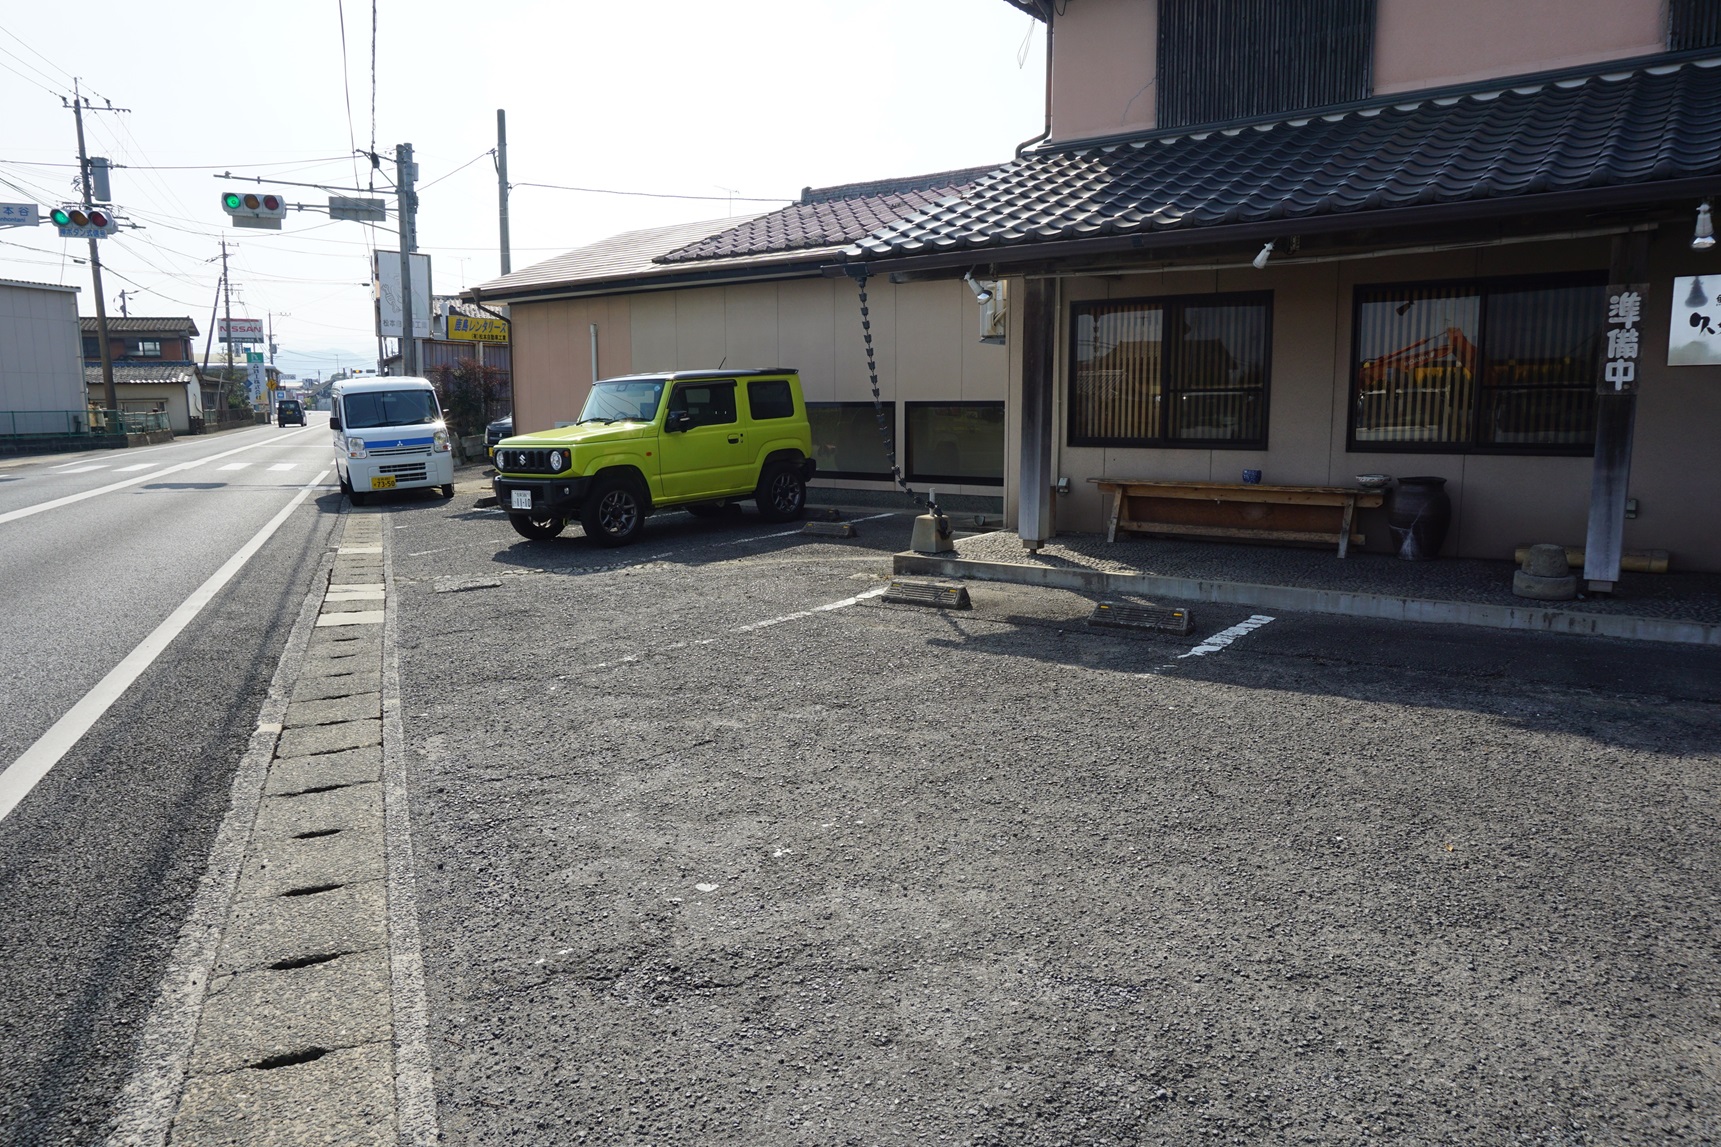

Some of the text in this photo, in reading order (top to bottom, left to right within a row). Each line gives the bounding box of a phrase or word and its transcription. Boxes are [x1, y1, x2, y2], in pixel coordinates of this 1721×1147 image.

[3, 206, 29, 216] 本谷
[454, 317, 507, 333] 鹿島レンタリース
[1605, 291, 1641, 391] 準備中
